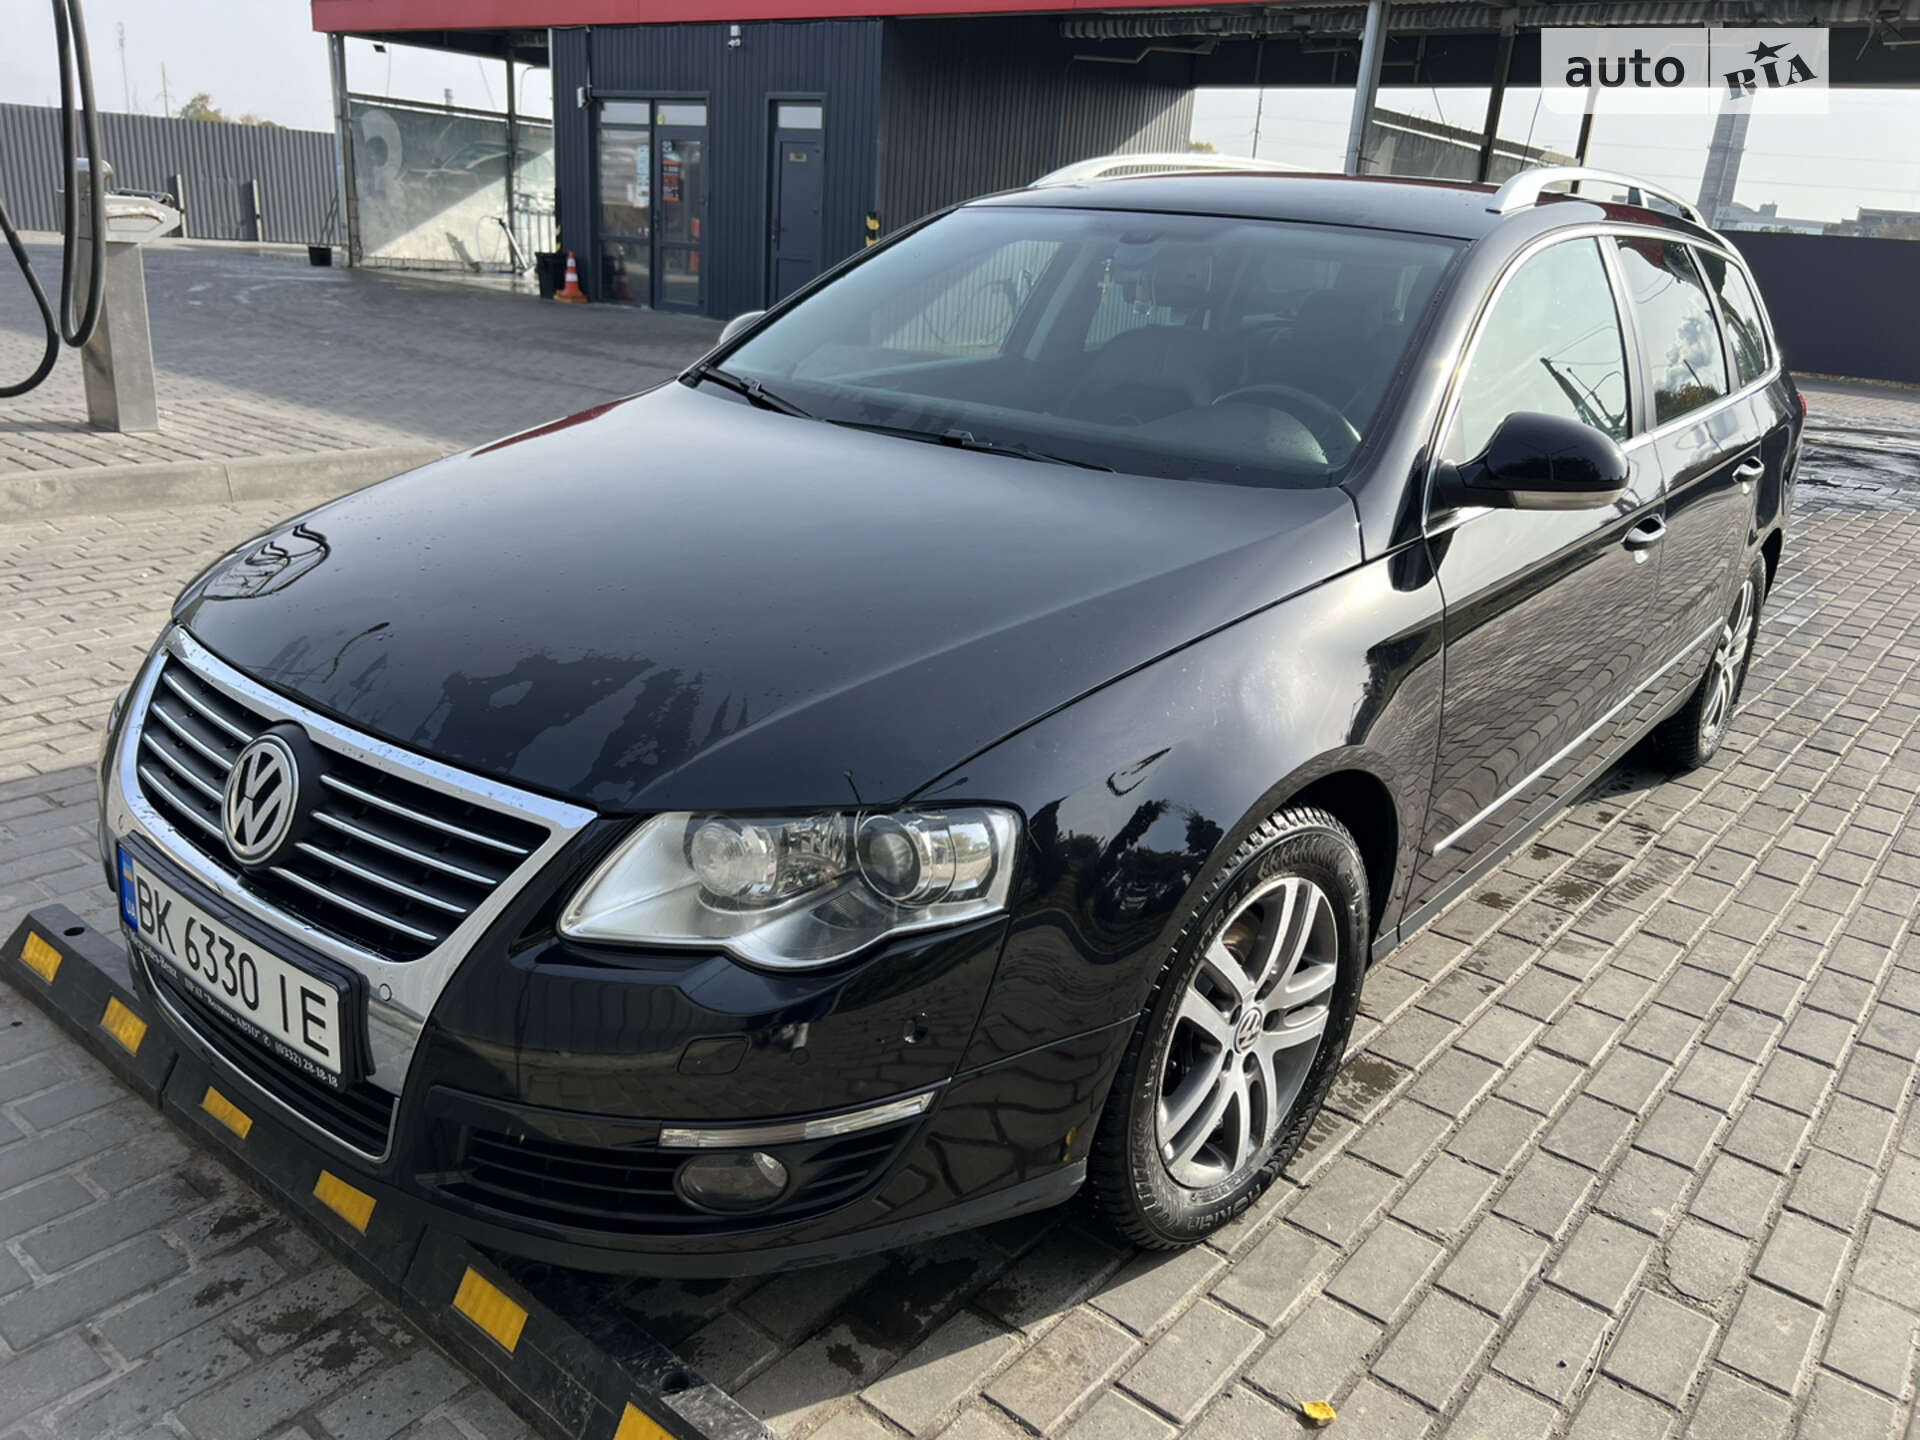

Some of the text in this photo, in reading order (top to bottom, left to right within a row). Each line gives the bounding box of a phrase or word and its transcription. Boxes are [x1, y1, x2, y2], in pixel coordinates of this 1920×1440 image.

[137, 876, 330, 1058] BK 6330 IE
